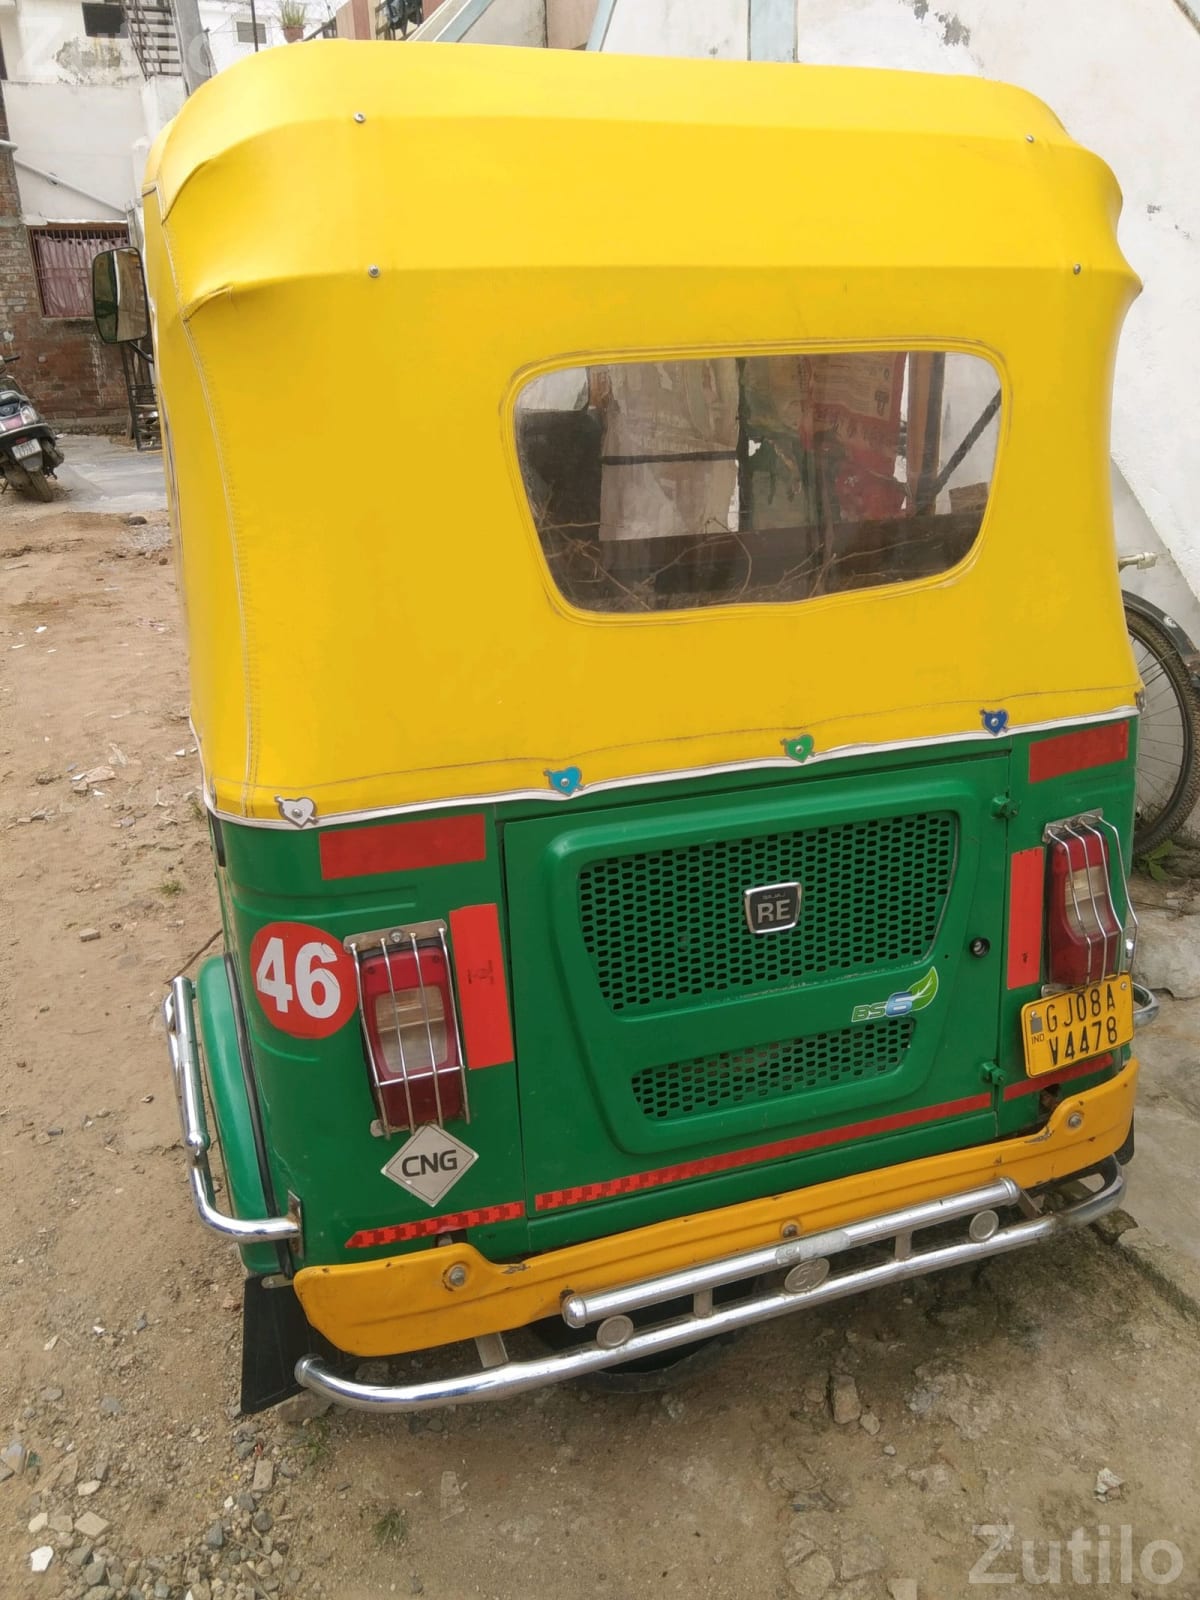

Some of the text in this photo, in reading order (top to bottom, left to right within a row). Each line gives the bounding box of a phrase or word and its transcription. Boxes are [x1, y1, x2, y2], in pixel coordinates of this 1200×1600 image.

[757, 899, 791, 924] RE
[256, 937, 341, 1019] 46
[851, 991, 914, 1022] BS6
[1046, 983, 1116, 1033] GJ08A
[1031, 1033, 1045, 1045] IND
[1048, 1016, 1118, 1065] V4478
[401, 1150, 458, 1177] CNG
